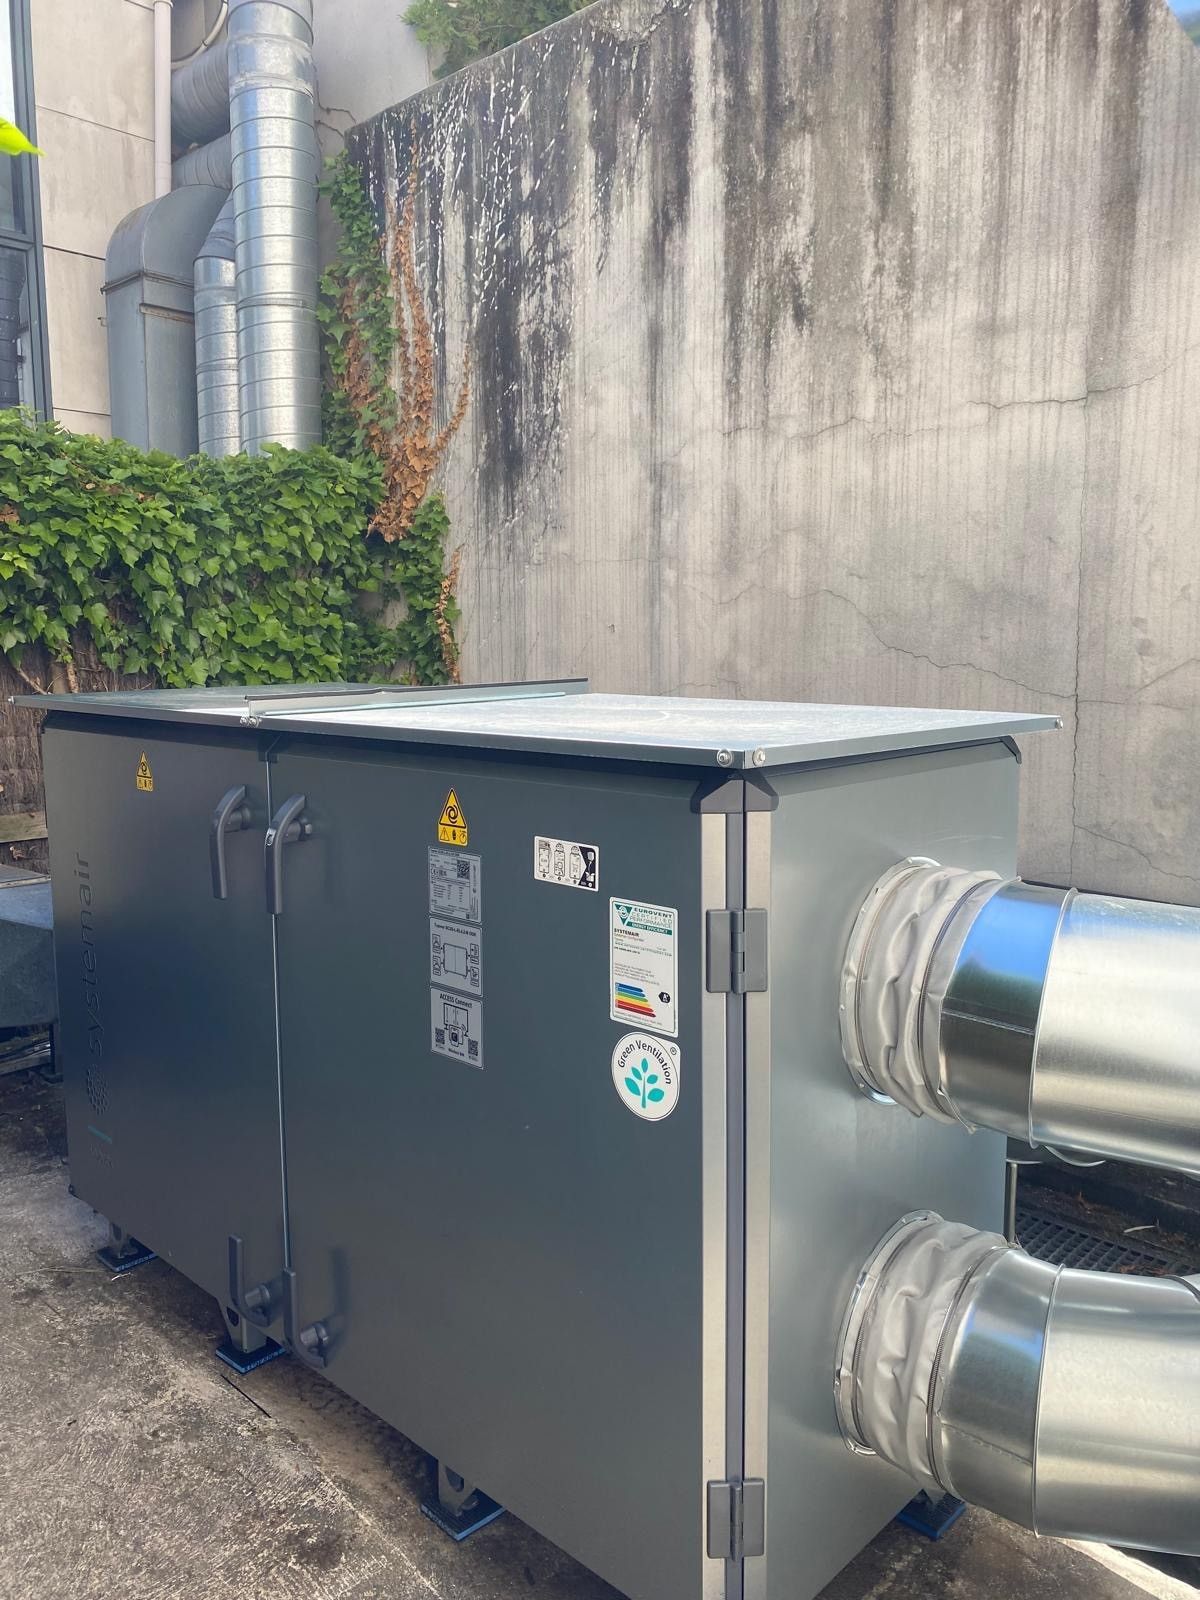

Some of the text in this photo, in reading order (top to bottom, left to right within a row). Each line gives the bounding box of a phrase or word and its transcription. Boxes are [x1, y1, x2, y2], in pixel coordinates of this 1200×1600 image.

[632, 912, 673, 924] CERTIFIED
[634, 907, 673, 918] EUROVENT
[614, 928, 639, 937] SYSTEMAIR
[74, 852, 104, 1056] systemair
[618, 1040, 672, 1085] Green Ventilation
